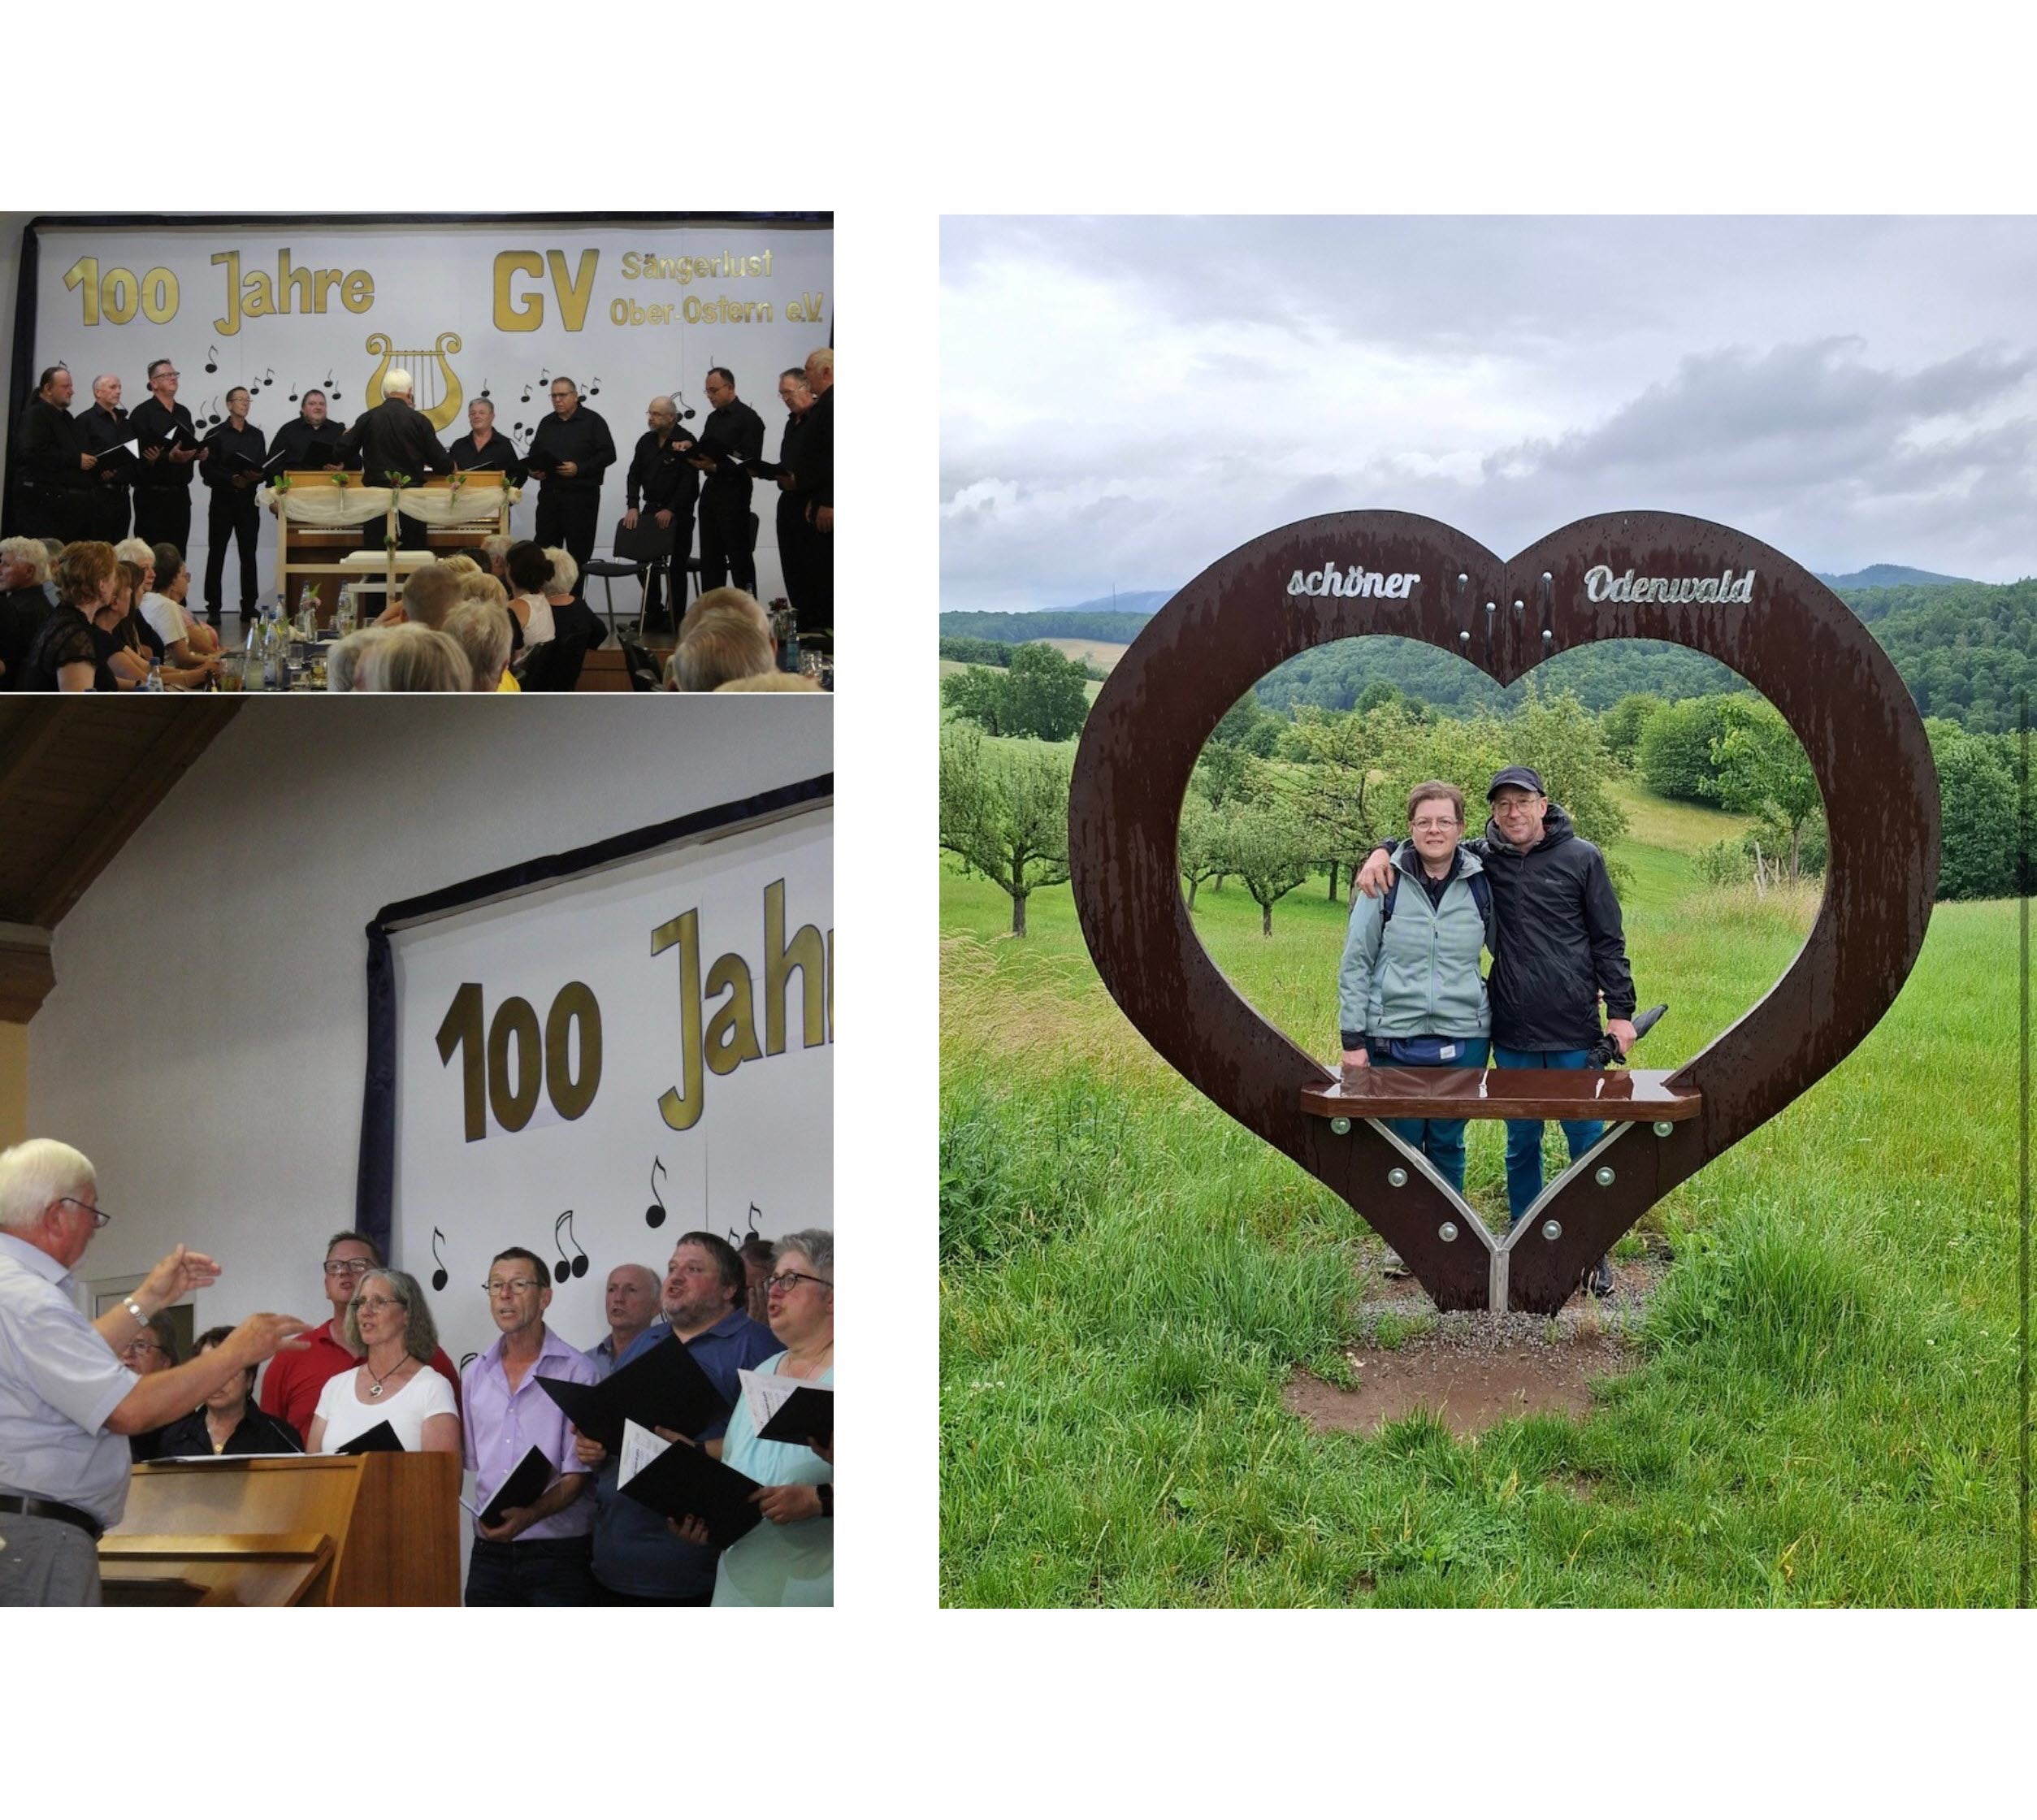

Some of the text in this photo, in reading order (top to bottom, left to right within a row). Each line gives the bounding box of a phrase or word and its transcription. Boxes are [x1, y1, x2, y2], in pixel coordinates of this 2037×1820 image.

[63, 248, 375, 336] 100 Jahre
[492, 249, 600, 332] GV
[621, 249, 774, 284] Sängerlust
[1286, 561, 1757, 604] schöner Odenwald
[435, 878, 834, 1143] 100 Jah
